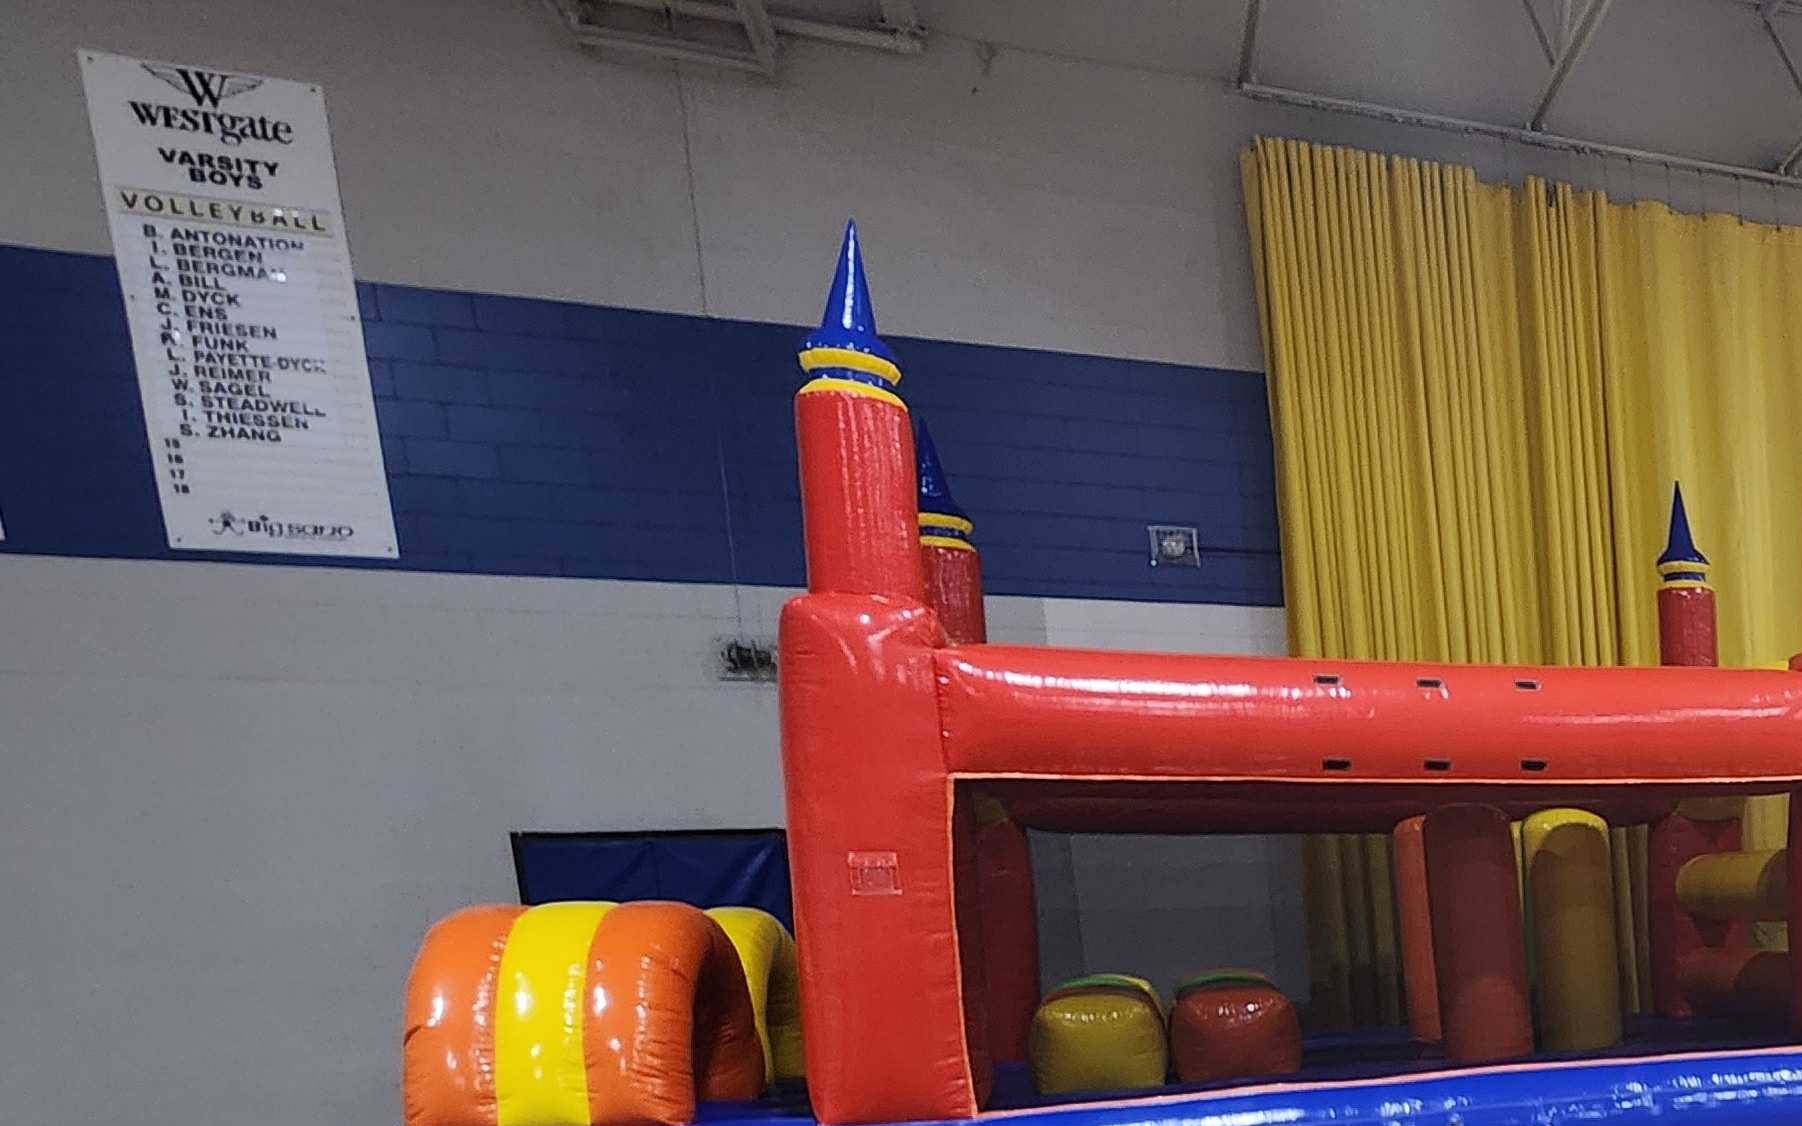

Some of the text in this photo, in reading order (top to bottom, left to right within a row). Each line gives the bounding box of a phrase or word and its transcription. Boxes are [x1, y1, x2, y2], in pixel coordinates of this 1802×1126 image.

[158, 147, 279, 176] VARSITY
[188, 167, 263, 189] BOYS
[120, 191, 326, 231] VOLLEYBALL
[143, 224, 163, 238] B.
[149, 256, 170, 270] L.
[173, 244, 262, 263] BERGEN
[152, 271, 226, 290] A. BILL
[154, 287, 240, 306] M. DYCK
[157, 302, 228, 320] C. ENS
[161, 318, 277, 339] J. FRIESEN
[192, 335, 249, 351] FUNK
[167, 348, 186, 361] L.
[169, 363, 271, 383] J. REIMER
[172, 379, 271, 398] W. SAGEL
[201, 396, 327, 417] STEADWELL
[204, 410, 309, 429] THIESSEN
[207, 425, 281, 442] ZHANG
